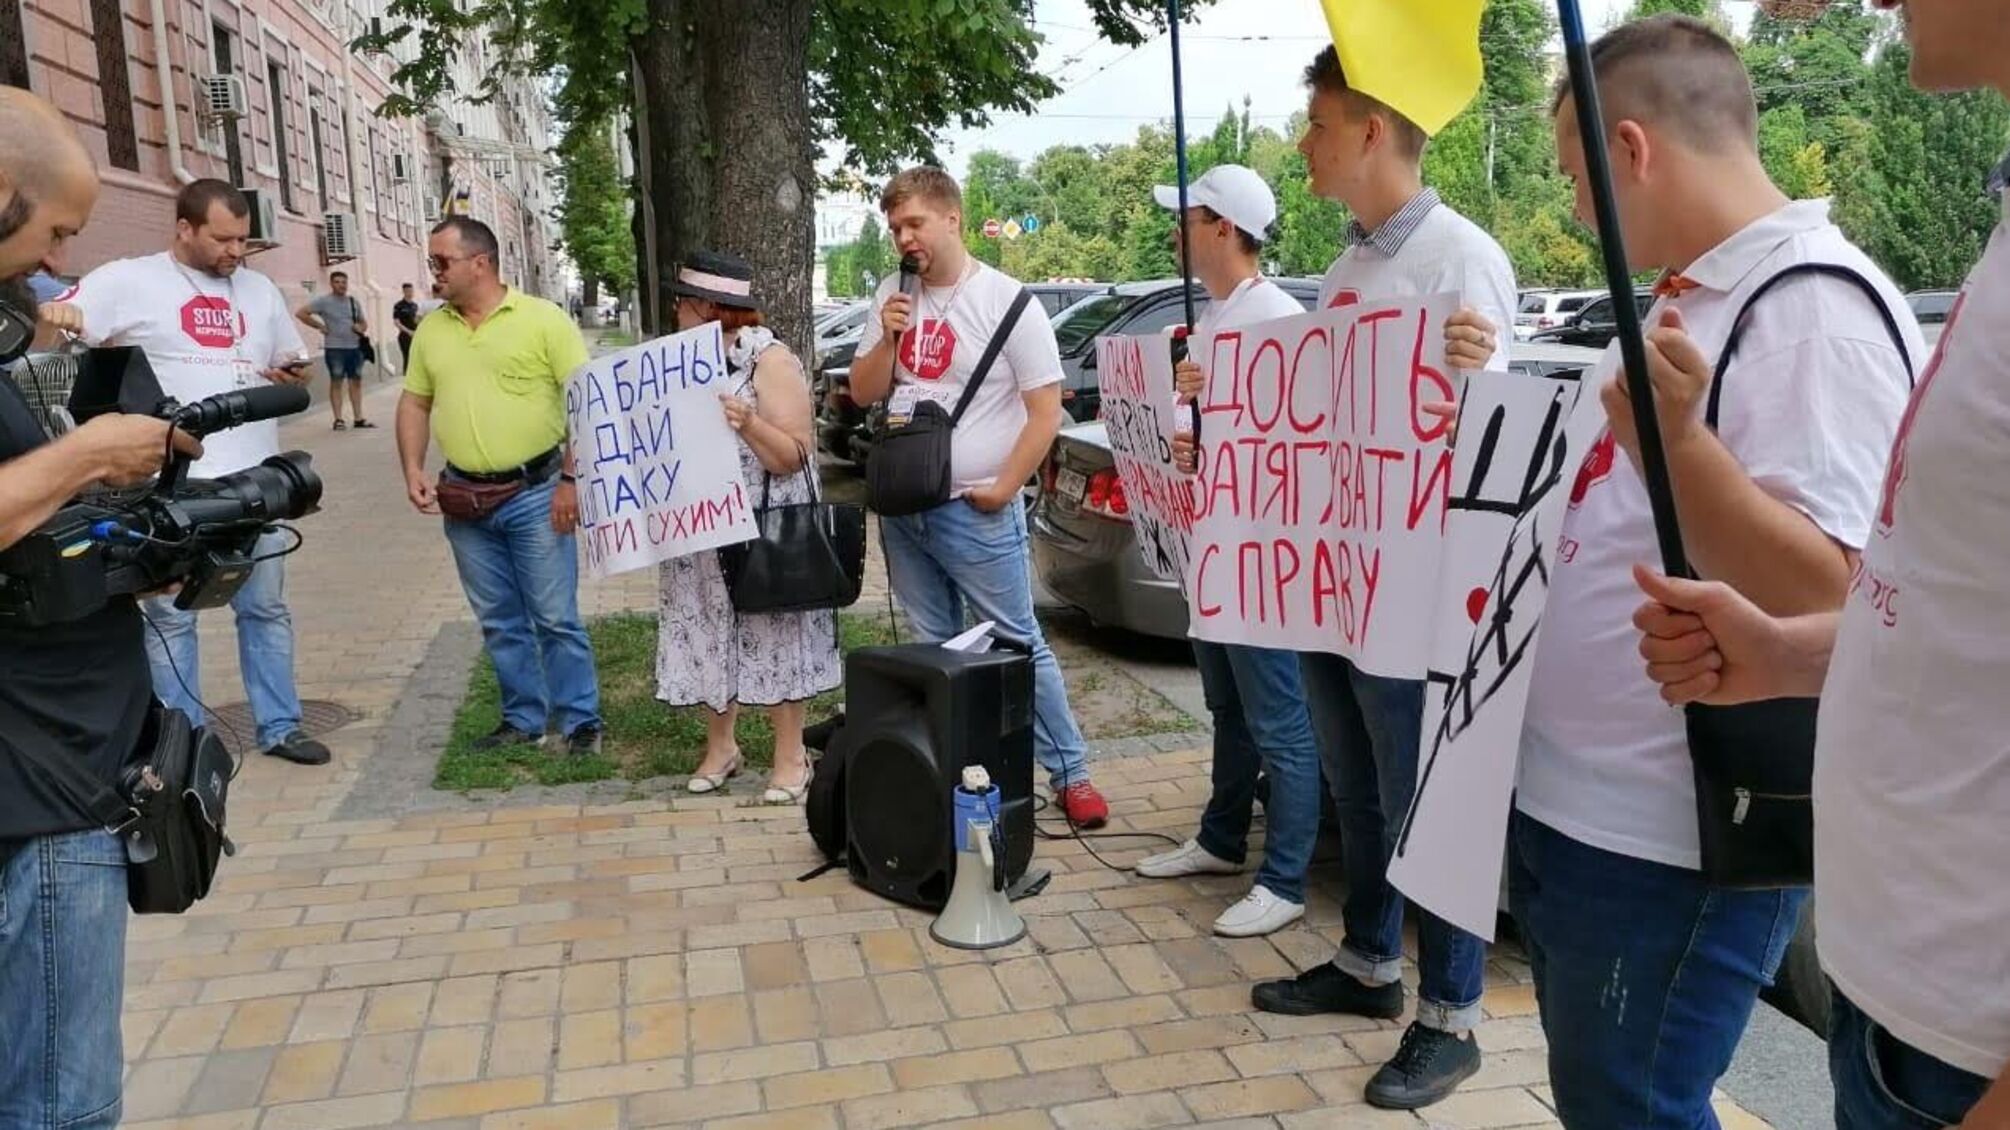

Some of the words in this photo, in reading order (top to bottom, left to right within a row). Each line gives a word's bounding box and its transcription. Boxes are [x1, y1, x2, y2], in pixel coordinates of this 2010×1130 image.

[193, 308, 232, 326] STOP
[1202, 308, 1455, 443] ДОСИТЬ
[594, 405, 674, 473] ДАЙ
[647, 483, 748, 545] СУХИМ!
[1192, 438, 1456, 537] ЗАТЯГУВАТИ
